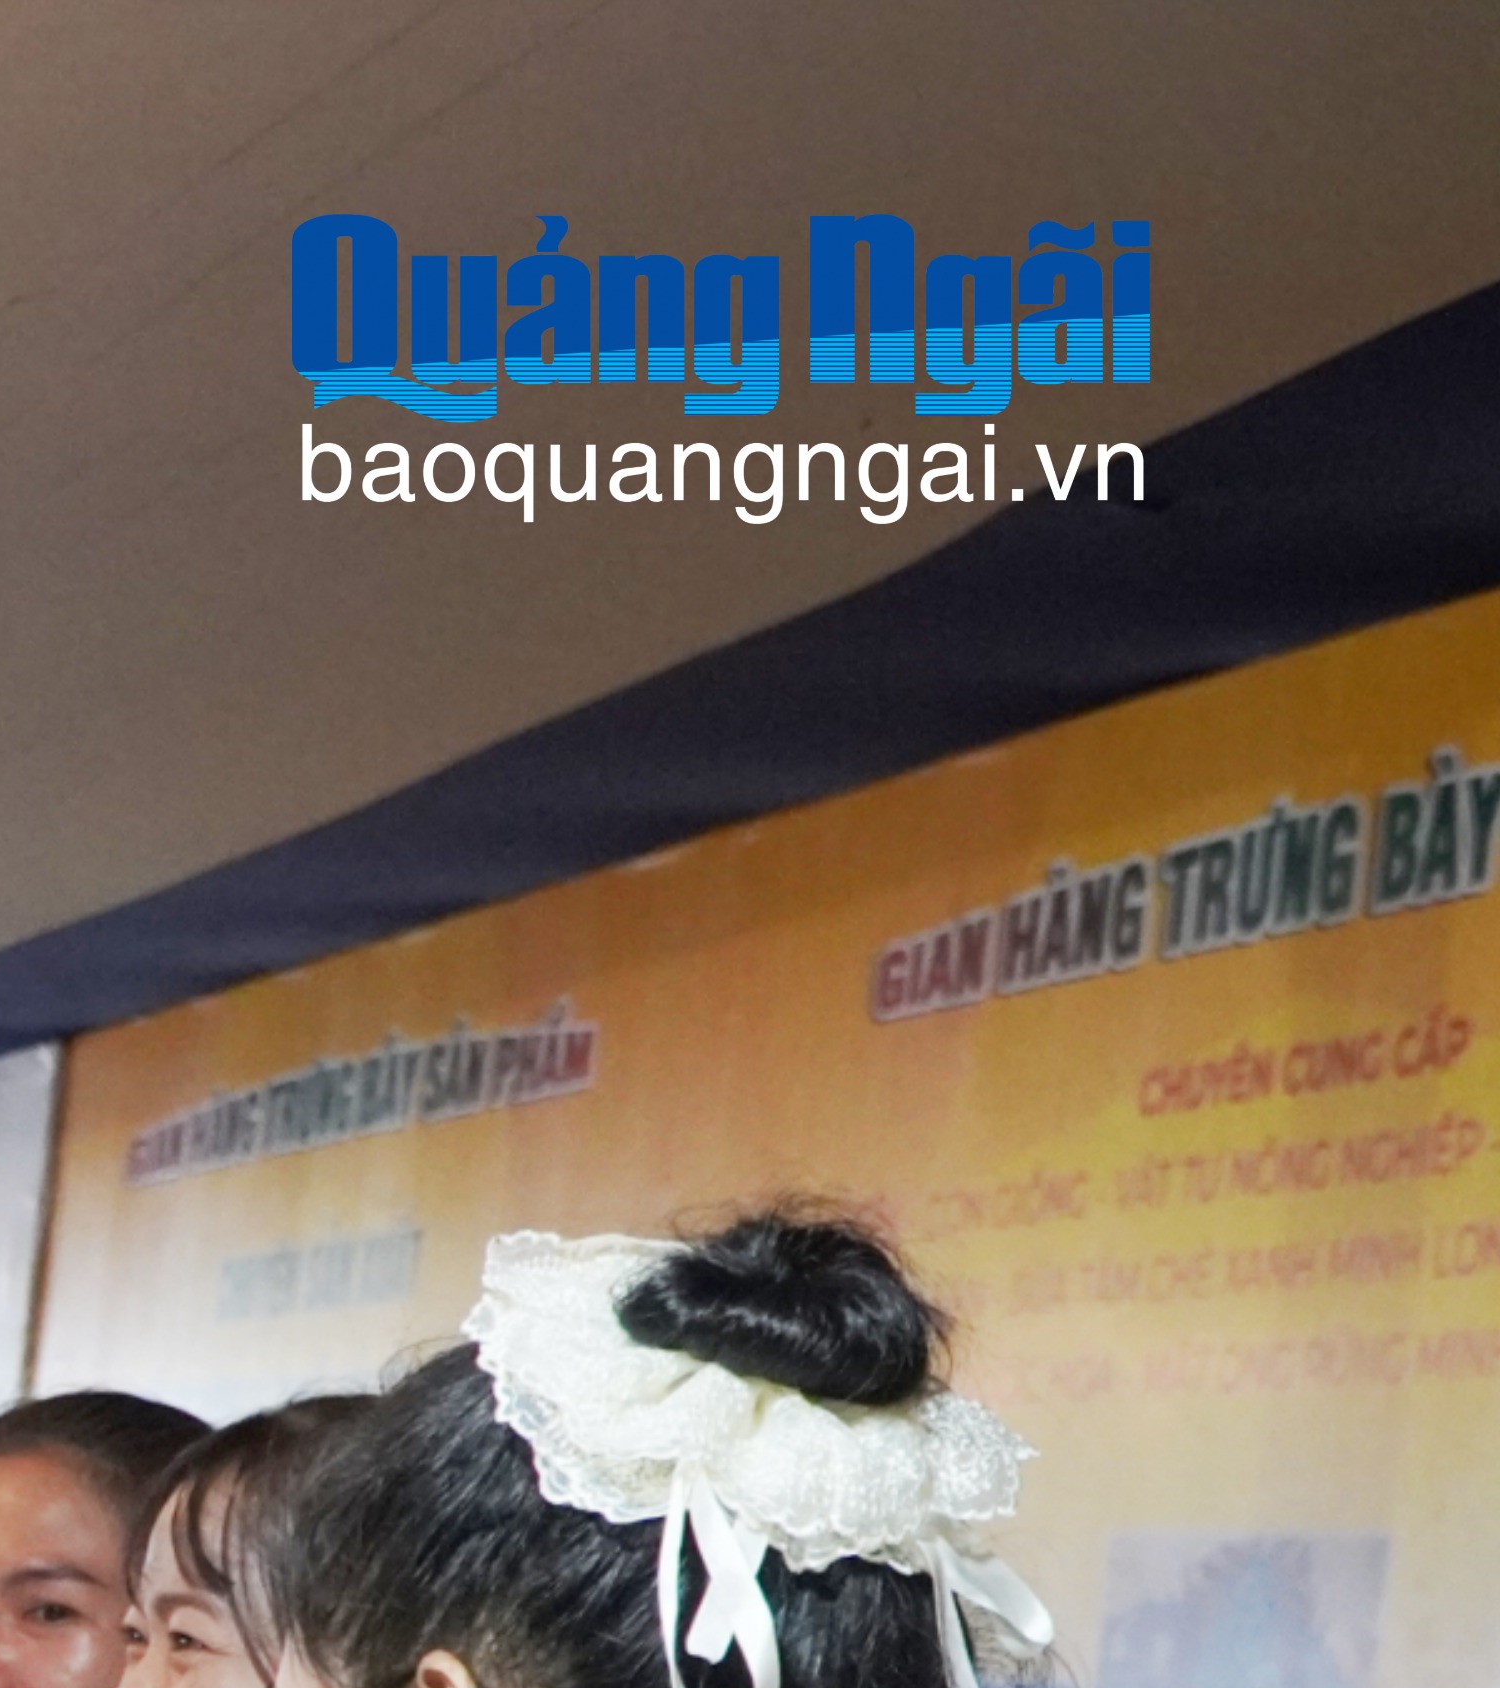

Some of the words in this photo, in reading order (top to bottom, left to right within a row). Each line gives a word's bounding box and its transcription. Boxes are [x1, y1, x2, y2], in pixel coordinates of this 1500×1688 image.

[876, 915, 991, 1008] GIAN
[1002, 862, 1146, 983] HÀNG
[1165, 802, 1357, 946] TRƯNG
[1379, 752, 1500, 899] BÀY
[1138, 1042, 1272, 1117] CHUYÊN
[1283, 1031, 1385, 1096] CUNG
